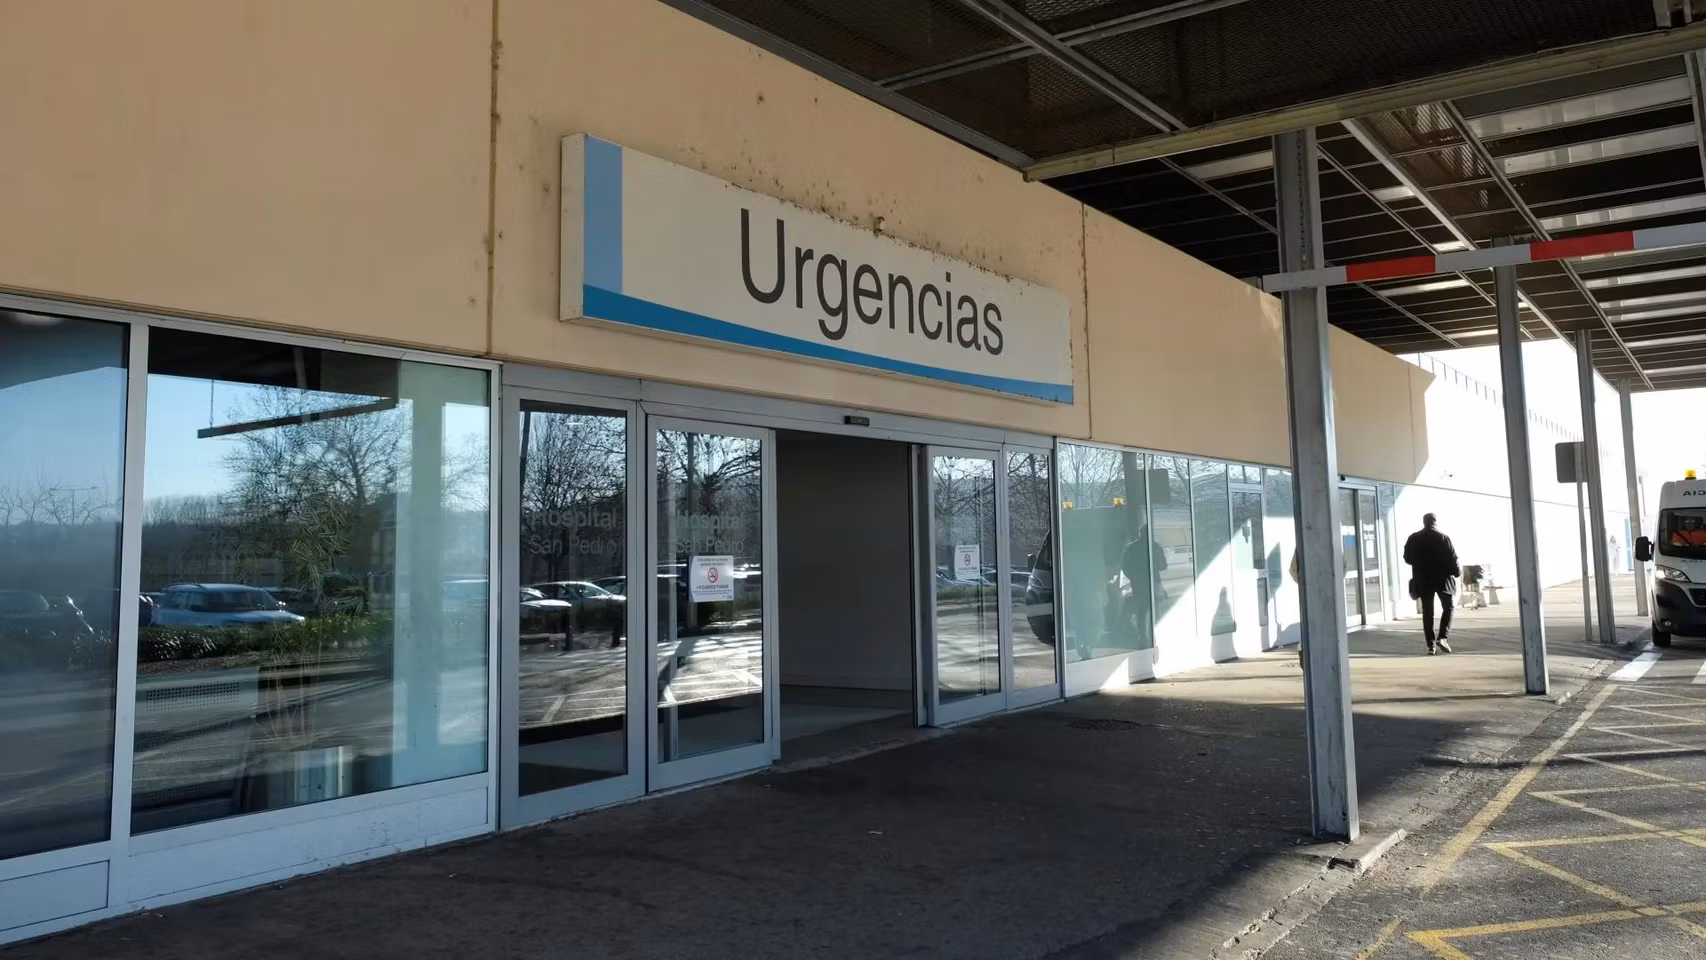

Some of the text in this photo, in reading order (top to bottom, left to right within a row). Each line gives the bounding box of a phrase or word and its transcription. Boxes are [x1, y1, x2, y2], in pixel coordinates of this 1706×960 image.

[741, 208, 1004, 356] Urgencias
[531, 508, 617, 531] Hospital
[676, 509, 744, 533] Hospital
[528, 535, 617, 555] San Pedro
[676, 536, 745, 553] San Pedro
